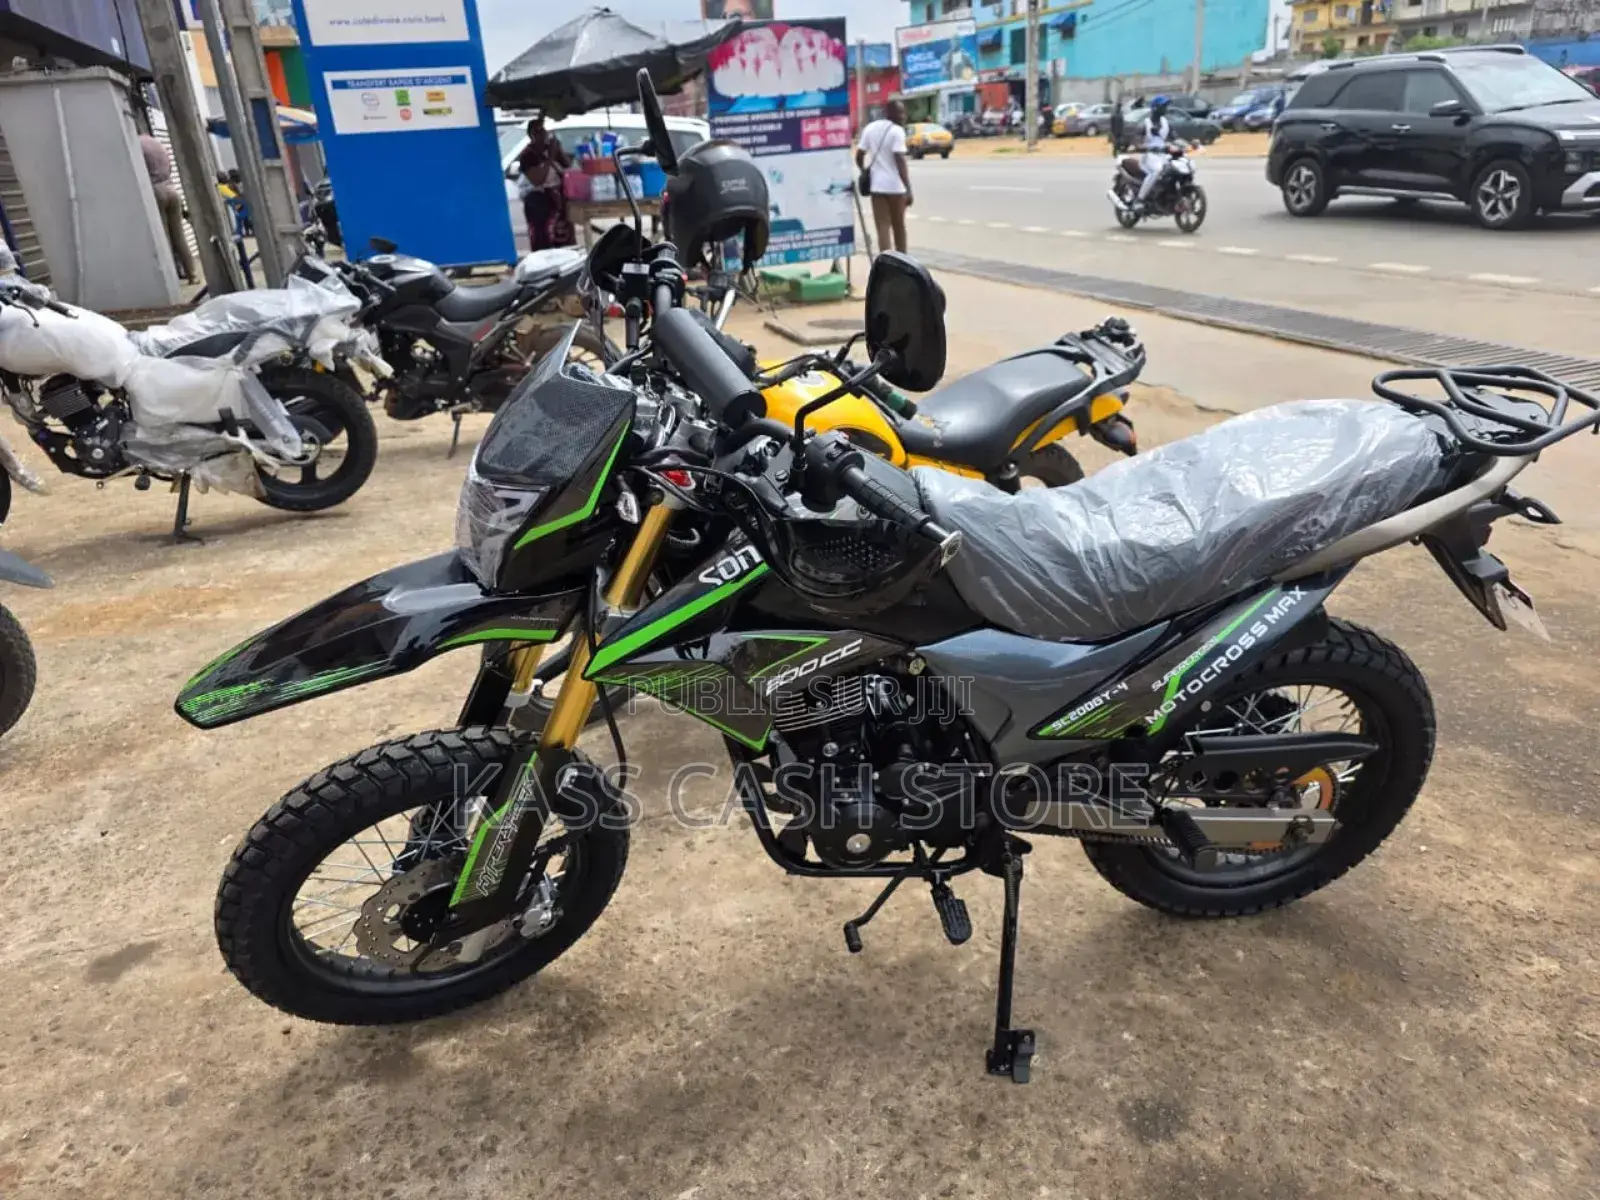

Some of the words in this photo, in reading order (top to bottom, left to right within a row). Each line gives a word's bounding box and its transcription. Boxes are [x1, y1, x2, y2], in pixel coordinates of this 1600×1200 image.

[1144, 620, 1268, 725] MOTOCROSS
[1264, 585, 1307, 625] MAX
[1051, 681, 1129, 731] SL200GY-4
